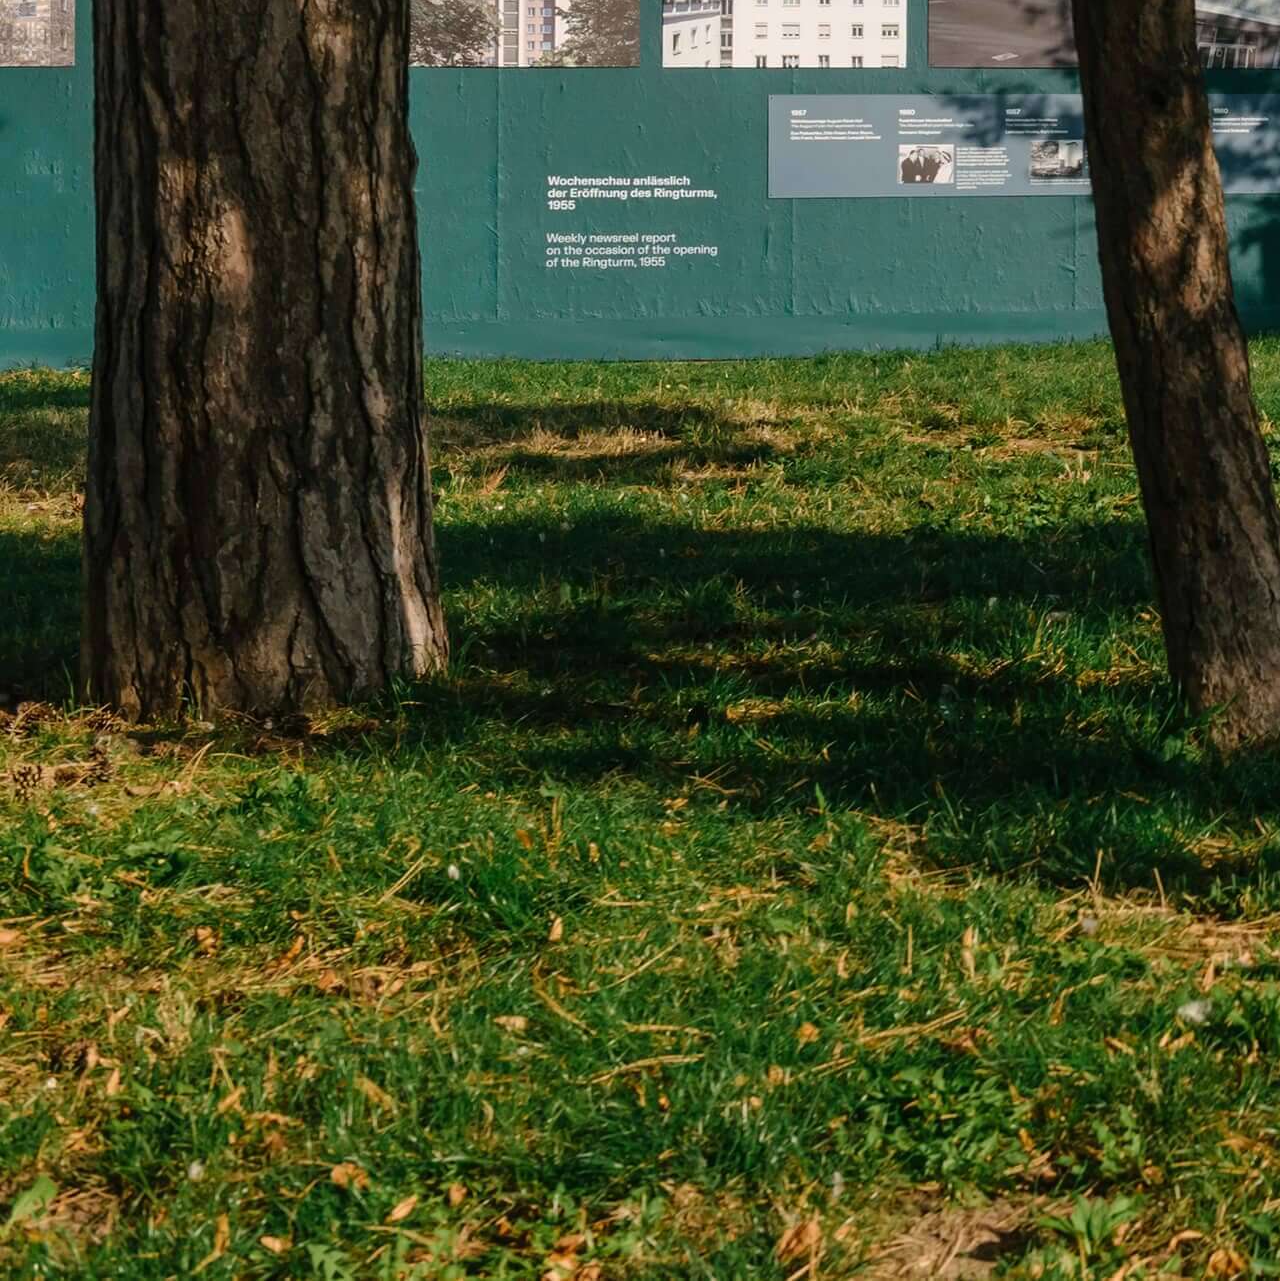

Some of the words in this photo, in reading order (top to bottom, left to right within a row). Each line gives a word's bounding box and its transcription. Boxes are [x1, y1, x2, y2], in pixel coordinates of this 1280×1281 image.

[547, 175, 631, 187] Wochenschau
[633, 175, 691, 186] anlässlich
[547, 188, 567, 198] der
[570, 187, 628, 200] Eröffnung
[630, 188, 651, 198] des
[654, 188, 718, 200] Ringturms,
[547, 200, 576, 210] 1955
[546, 233, 587, 245] Weekly
[589, 233, 639, 243] newsreel
[641, 233, 676, 245] report
[546, 247, 561, 256] on
[563, 245, 583, 255] the
[585, 245, 635, 255] occasion
[637, 245, 649, 255] of
[652, 245, 670, 255] the
[673, 245, 718, 257] opening
[546, 257, 559, 268] of
[561, 257, 580, 267] the
[582, 256, 637, 269] Ringturm,
[640, 256, 666, 267] 1955
